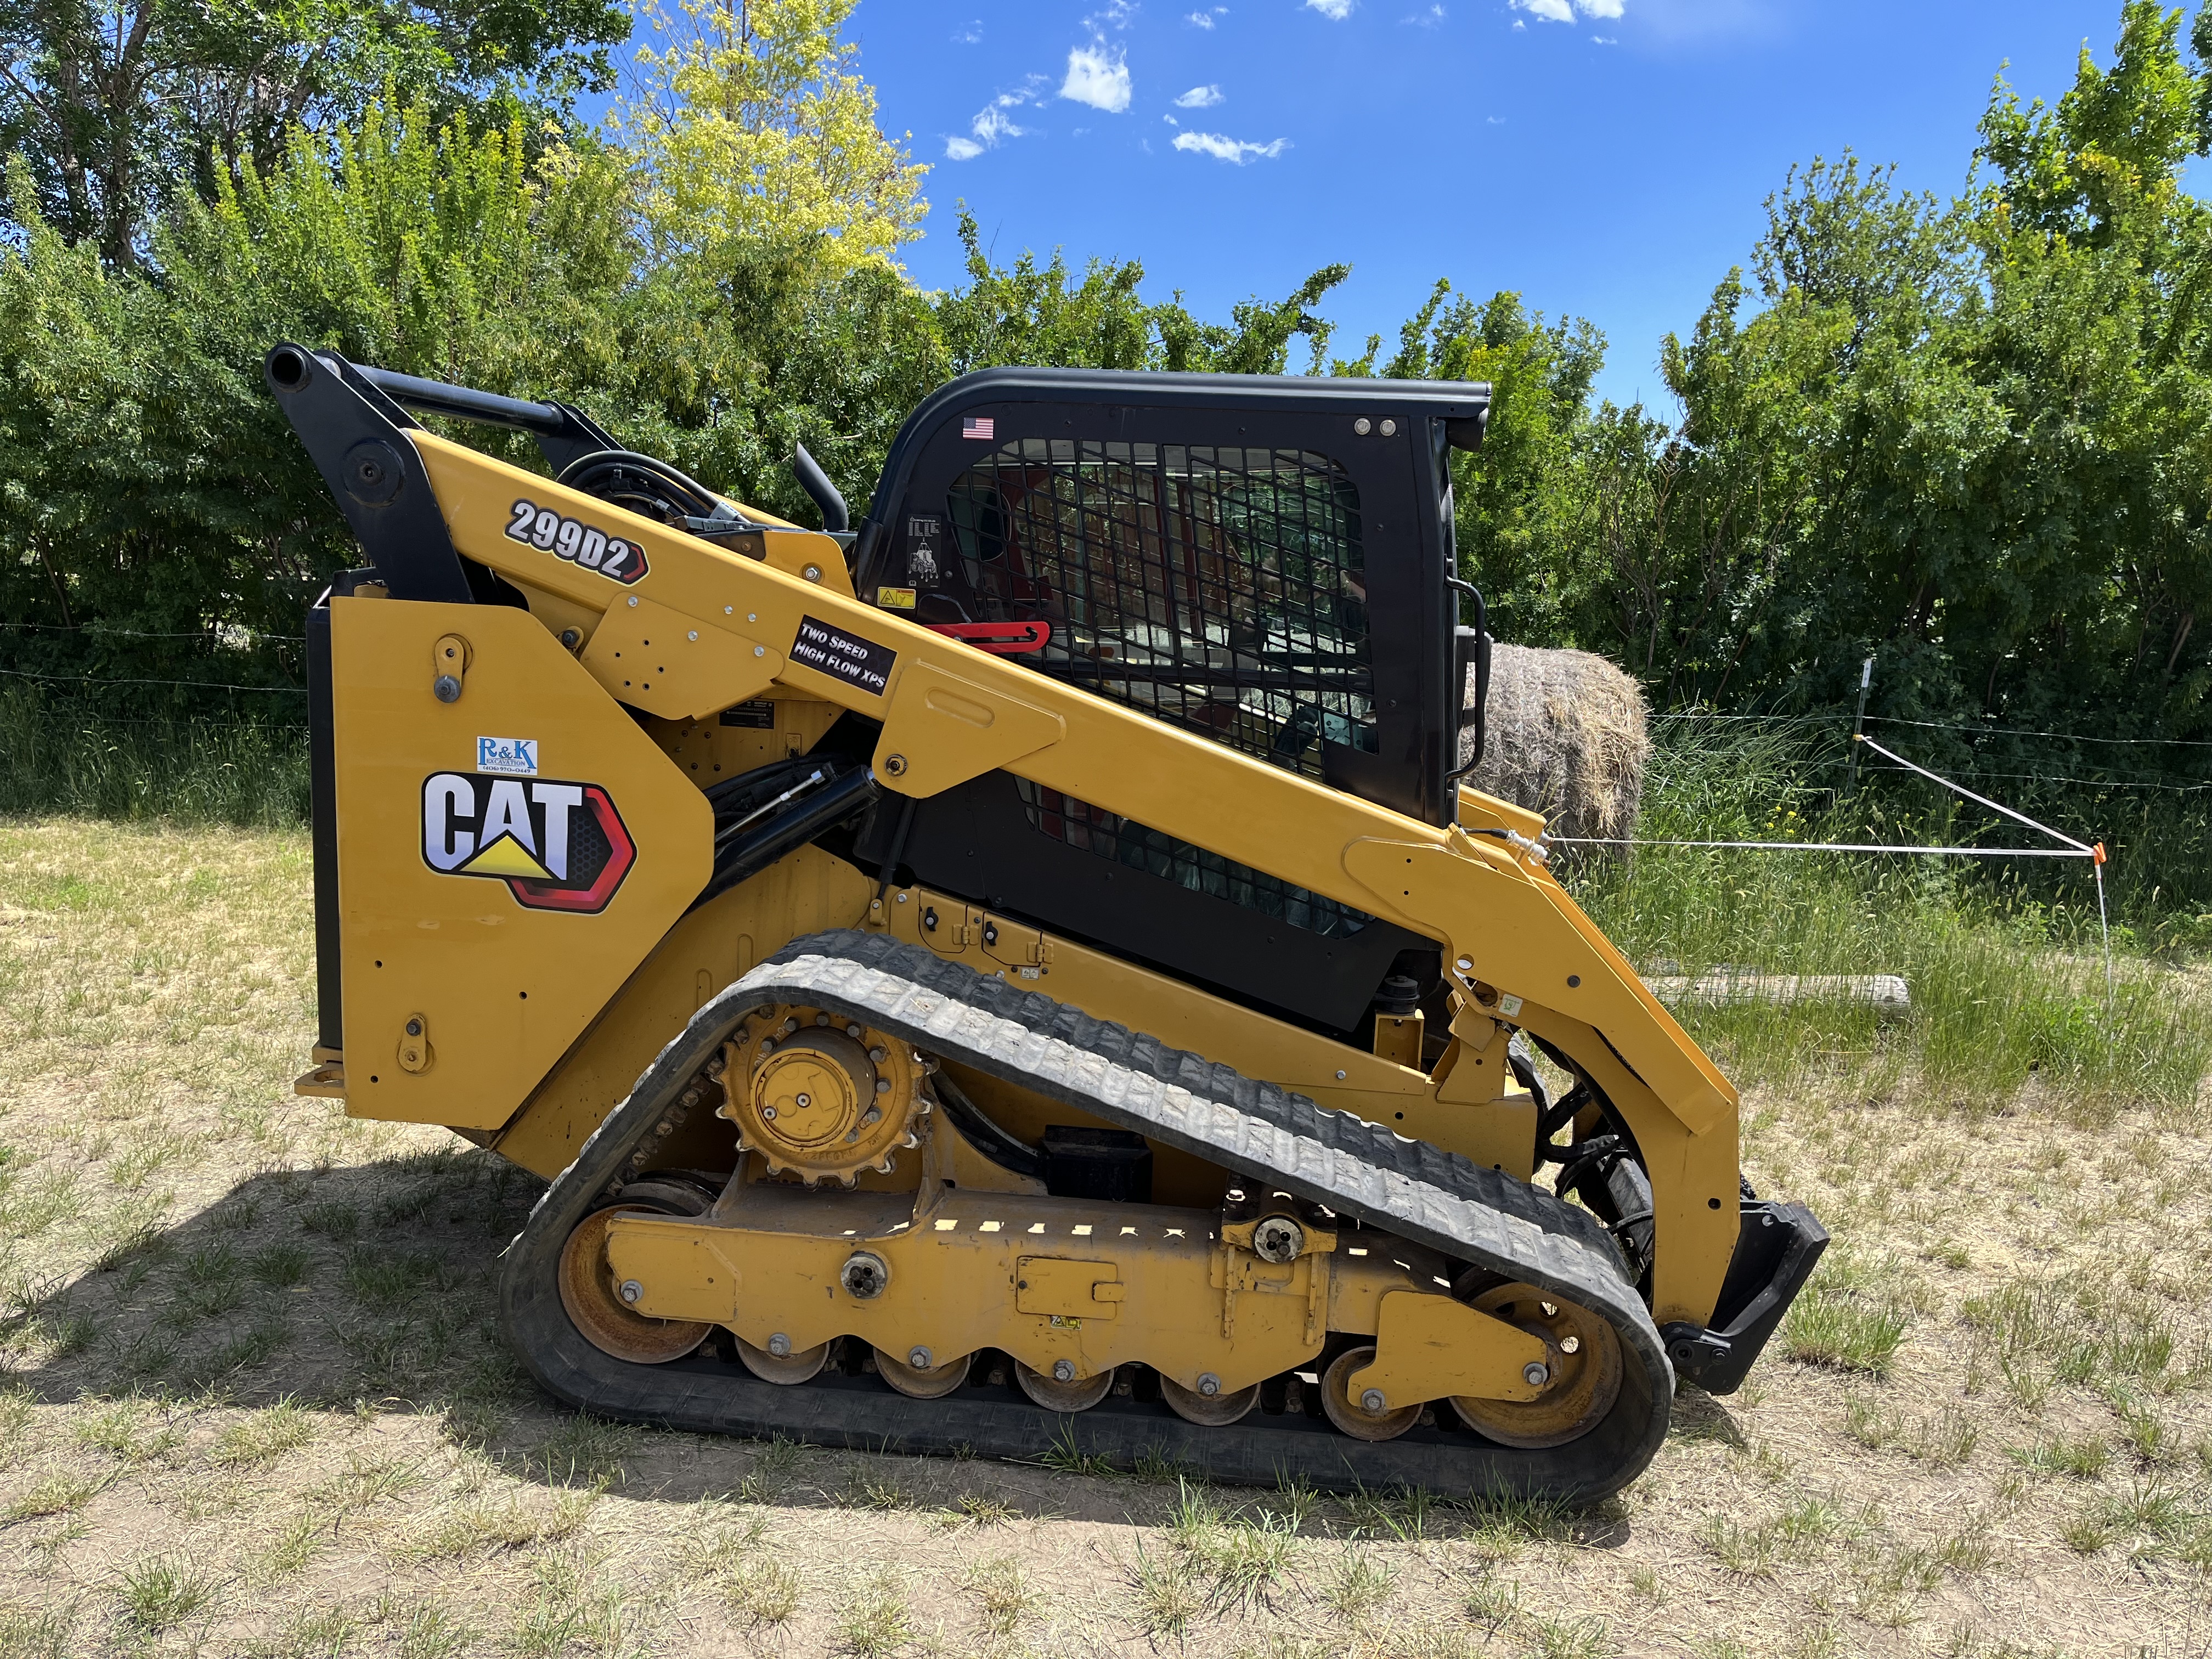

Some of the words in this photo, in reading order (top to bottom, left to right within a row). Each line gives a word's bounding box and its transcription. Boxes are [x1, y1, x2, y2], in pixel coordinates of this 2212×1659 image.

[508, 503, 629, 577] 299D2
[794, 641, 826, 663] HIGH
[826, 654, 862, 677] FLOW
[860, 669, 885, 687] XPS
[801, 623, 828, 644] TWO
[828, 635, 868, 660] SPEED
[486, 758, 526, 766] EXCAVATION
[425, 774, 582, 880] CAT
